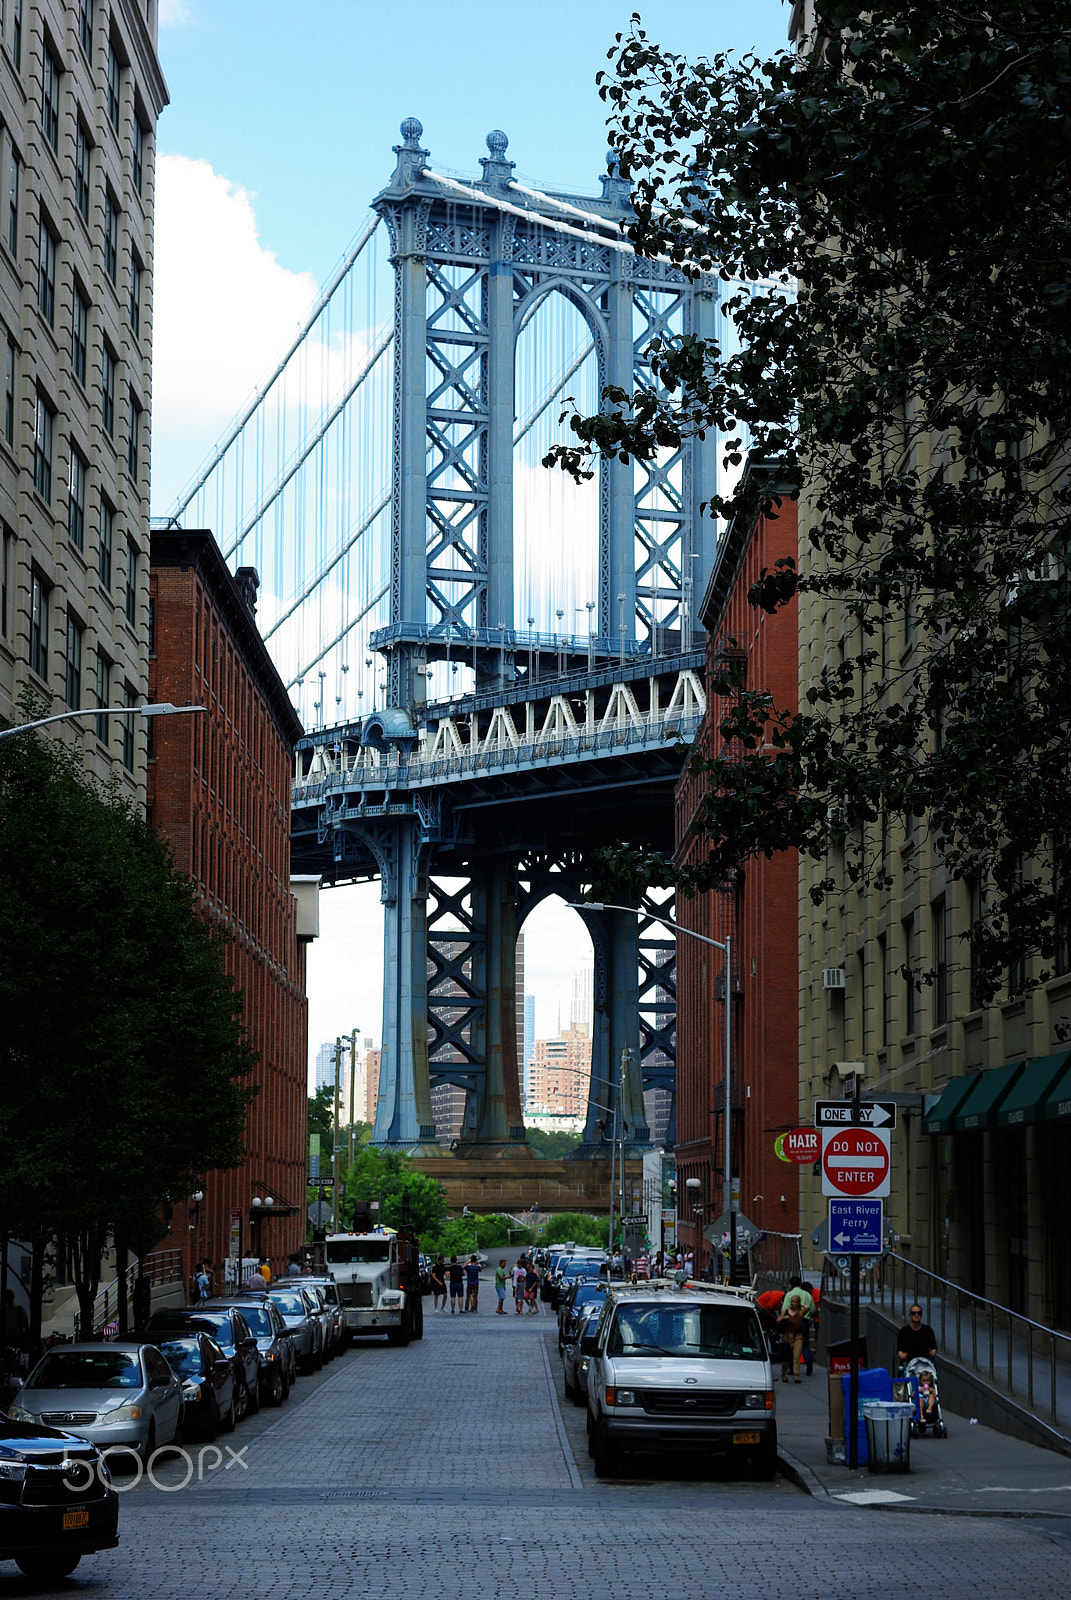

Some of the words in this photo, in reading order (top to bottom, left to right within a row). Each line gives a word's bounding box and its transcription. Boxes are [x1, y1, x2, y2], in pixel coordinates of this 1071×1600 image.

[824, 1109, 847, 1120] ONE
[789, 1133, 818, 1148] HAIR
[833, 1141, 849, 1152] DO
[856, 1142, 879, 1153] NOT
[837, 1171, 875, 1182] ENTER
[832, 1205, 852, 1215] East
[856, 1205, 880, 1215] River
[842, 1219, 869, 1230] Ferry
